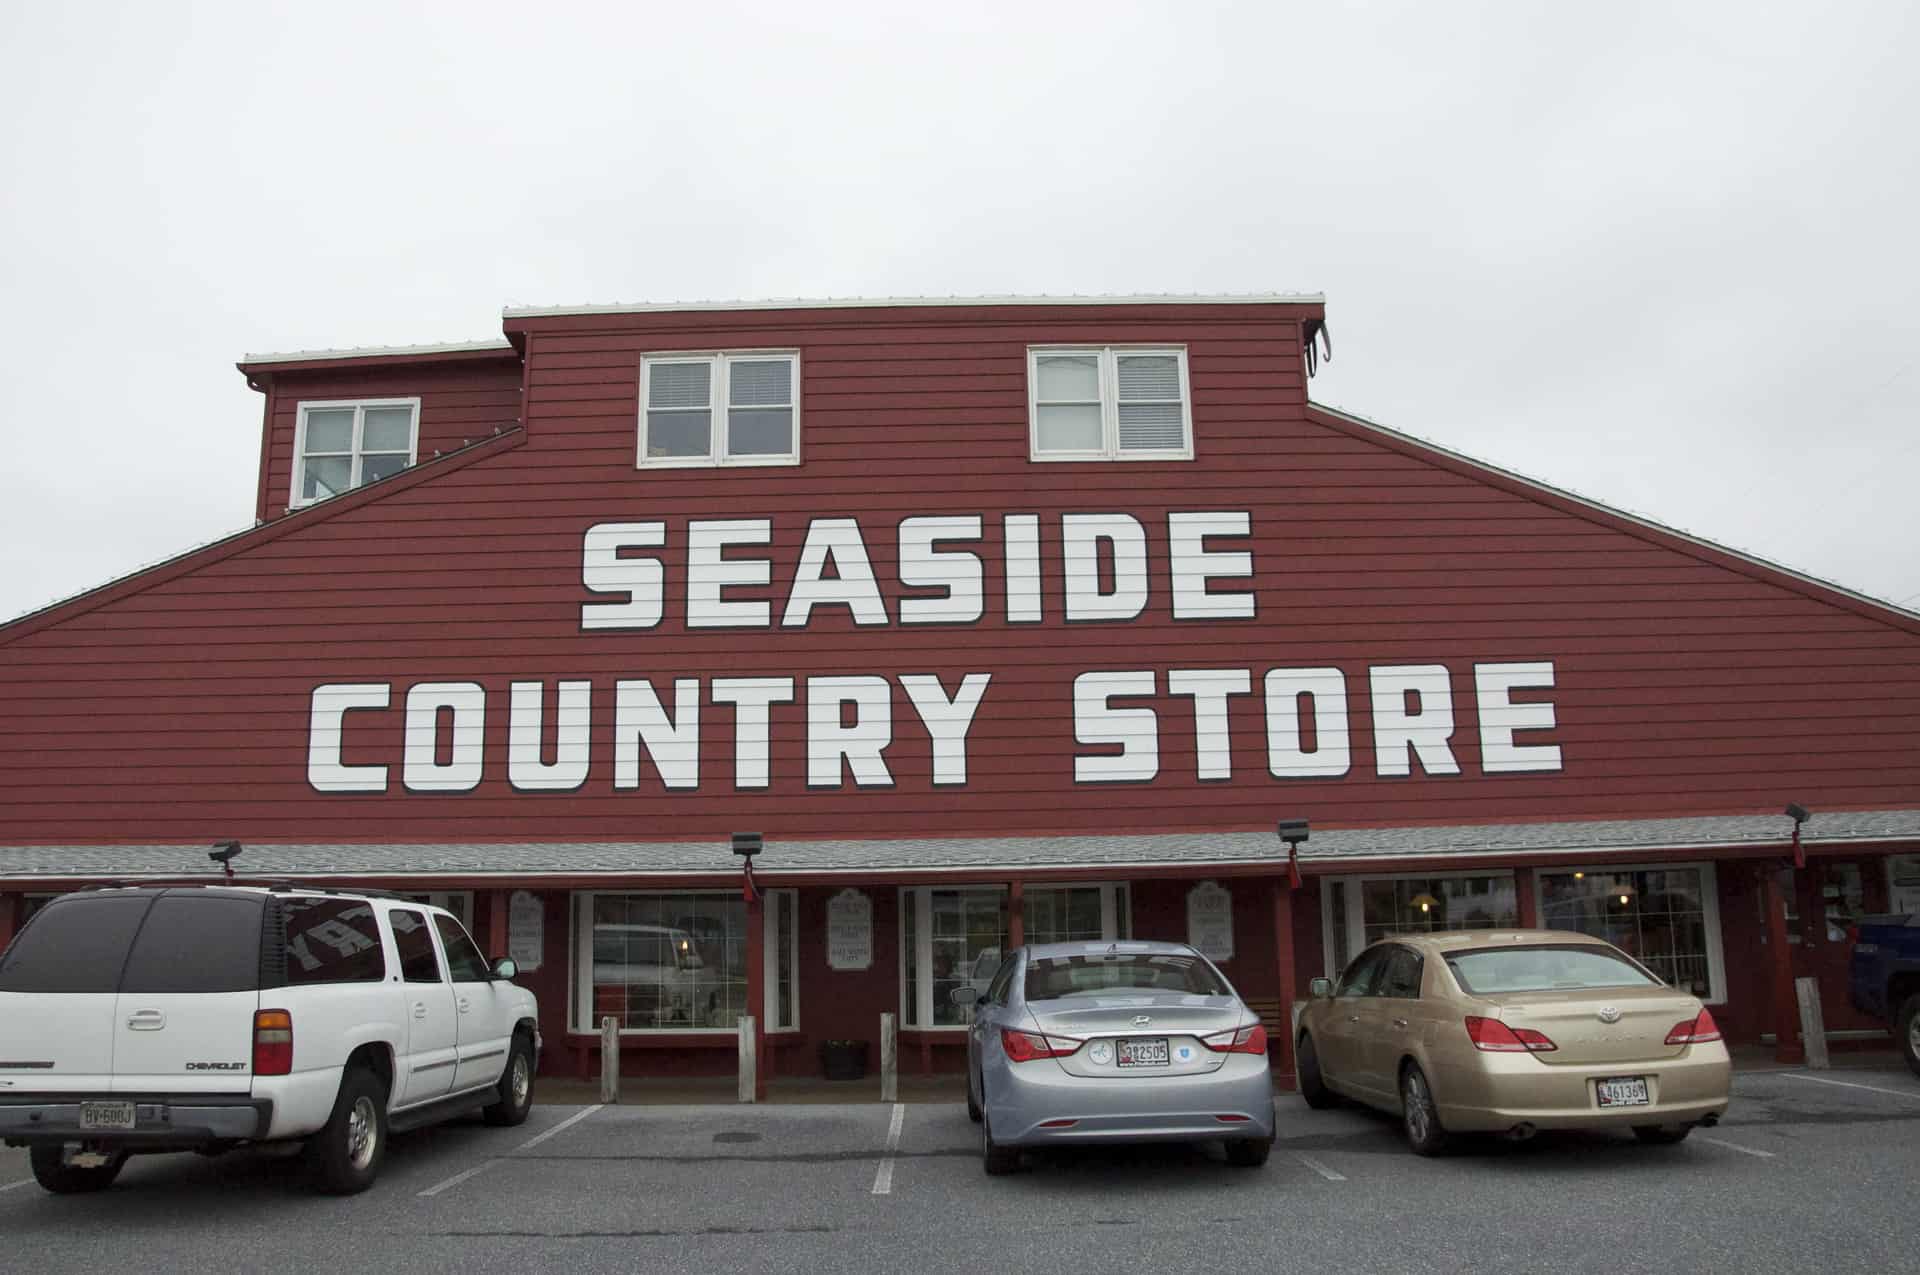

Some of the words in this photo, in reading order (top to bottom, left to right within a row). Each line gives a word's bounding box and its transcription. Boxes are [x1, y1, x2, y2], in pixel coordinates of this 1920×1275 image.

[580, 510, 1257, 631] SEASIDE
[307, 672, 992, 792] COUNTRY
[1073, 661, 1564, 783] STORE
[186, 1062, 247, 1071] CHEVROLET
